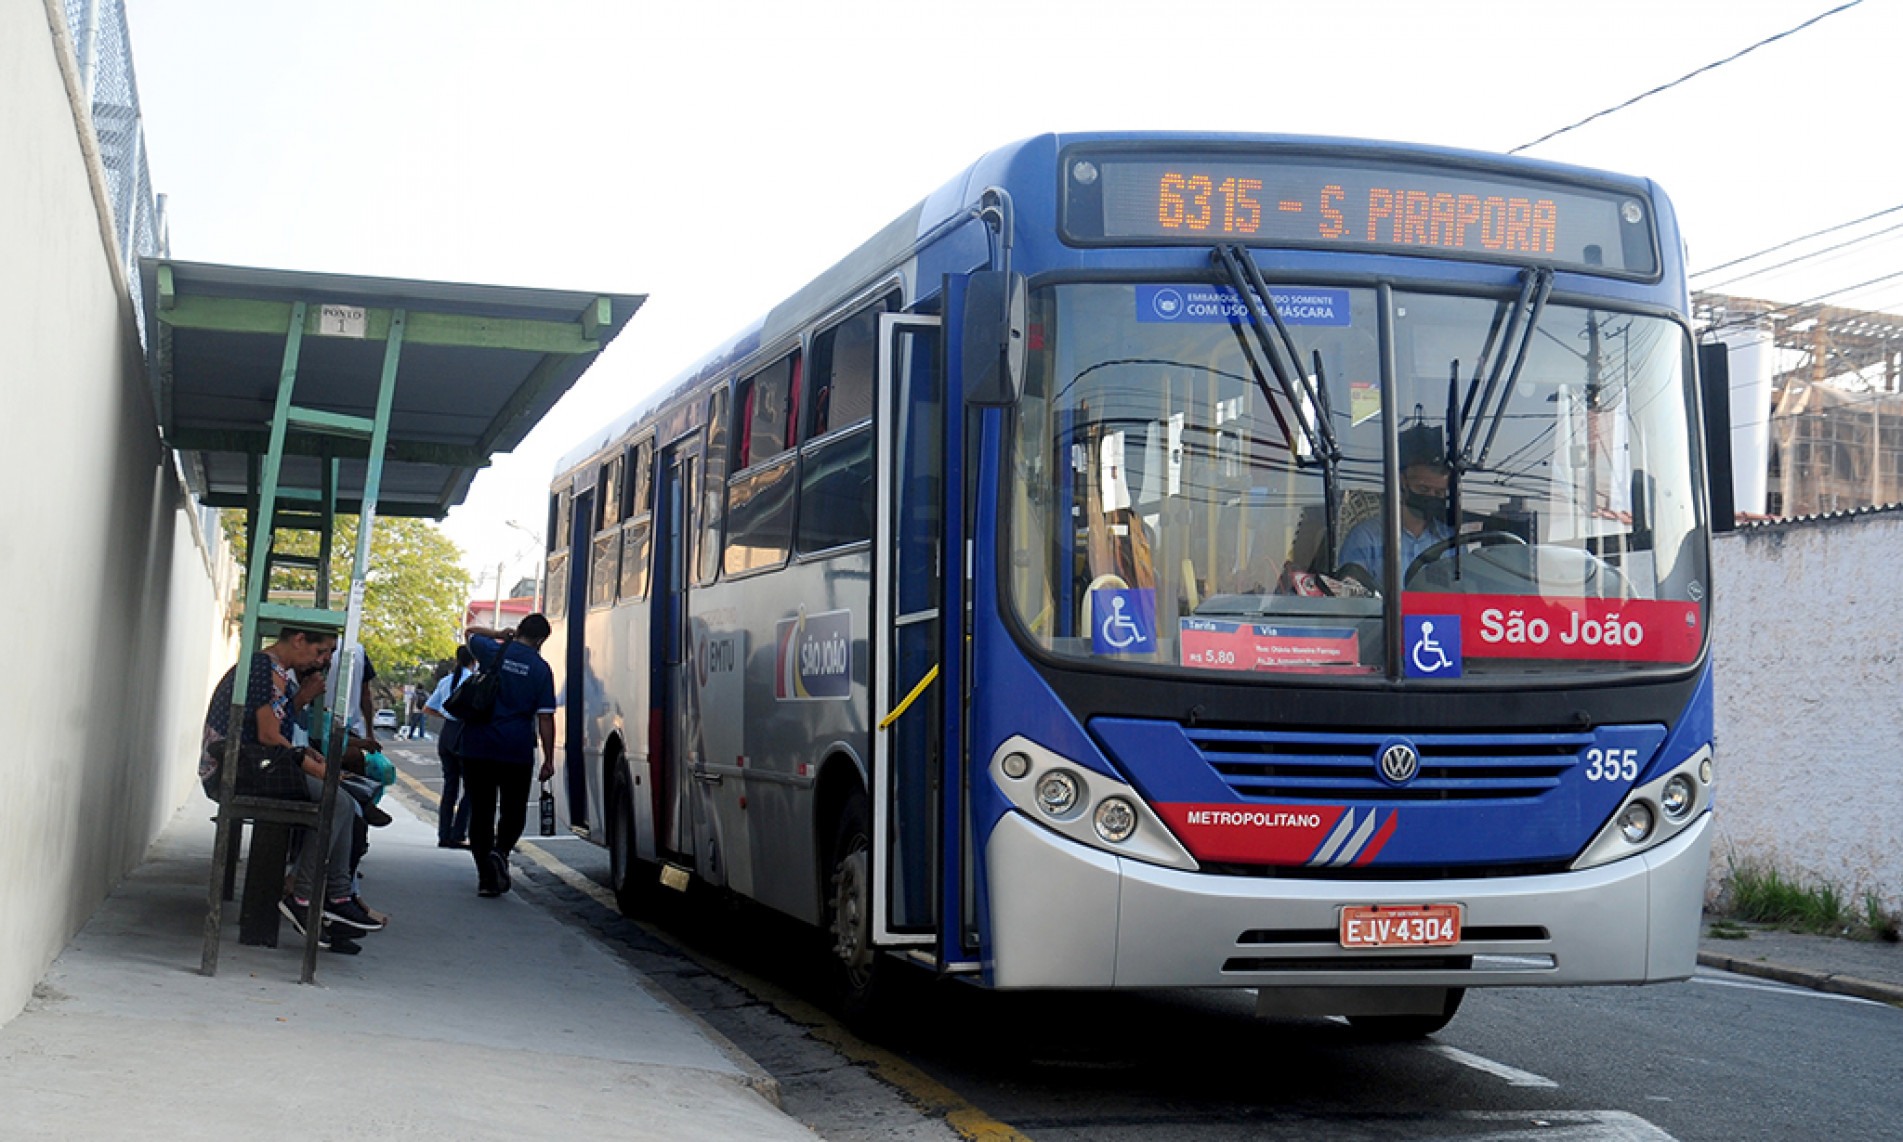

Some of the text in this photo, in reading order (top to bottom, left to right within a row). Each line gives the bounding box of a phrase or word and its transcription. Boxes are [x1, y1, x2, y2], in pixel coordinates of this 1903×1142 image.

[1159, 172, 1263, 233] 6315
[1319, 184, 1350, 239] S.
[1368, 188, 1557, 252] PIRAPORA
[324, 307, 362, 320] PONTO
[1187, 304, 1218, 316] COM
[1221, 305, 1248, 317] USO
[337, 319, 346, 333] 1
[1261, 626, 1278, 636] Via
[1480, 609, 1643, 646] São João
[710, 640, 735, 673] EMTU
[1189, 649, 1235, 664] R$ 5,80
[1586, 748, 1638, 782] 355
[1187, 810, 1320, 828] METROPOLITANO
